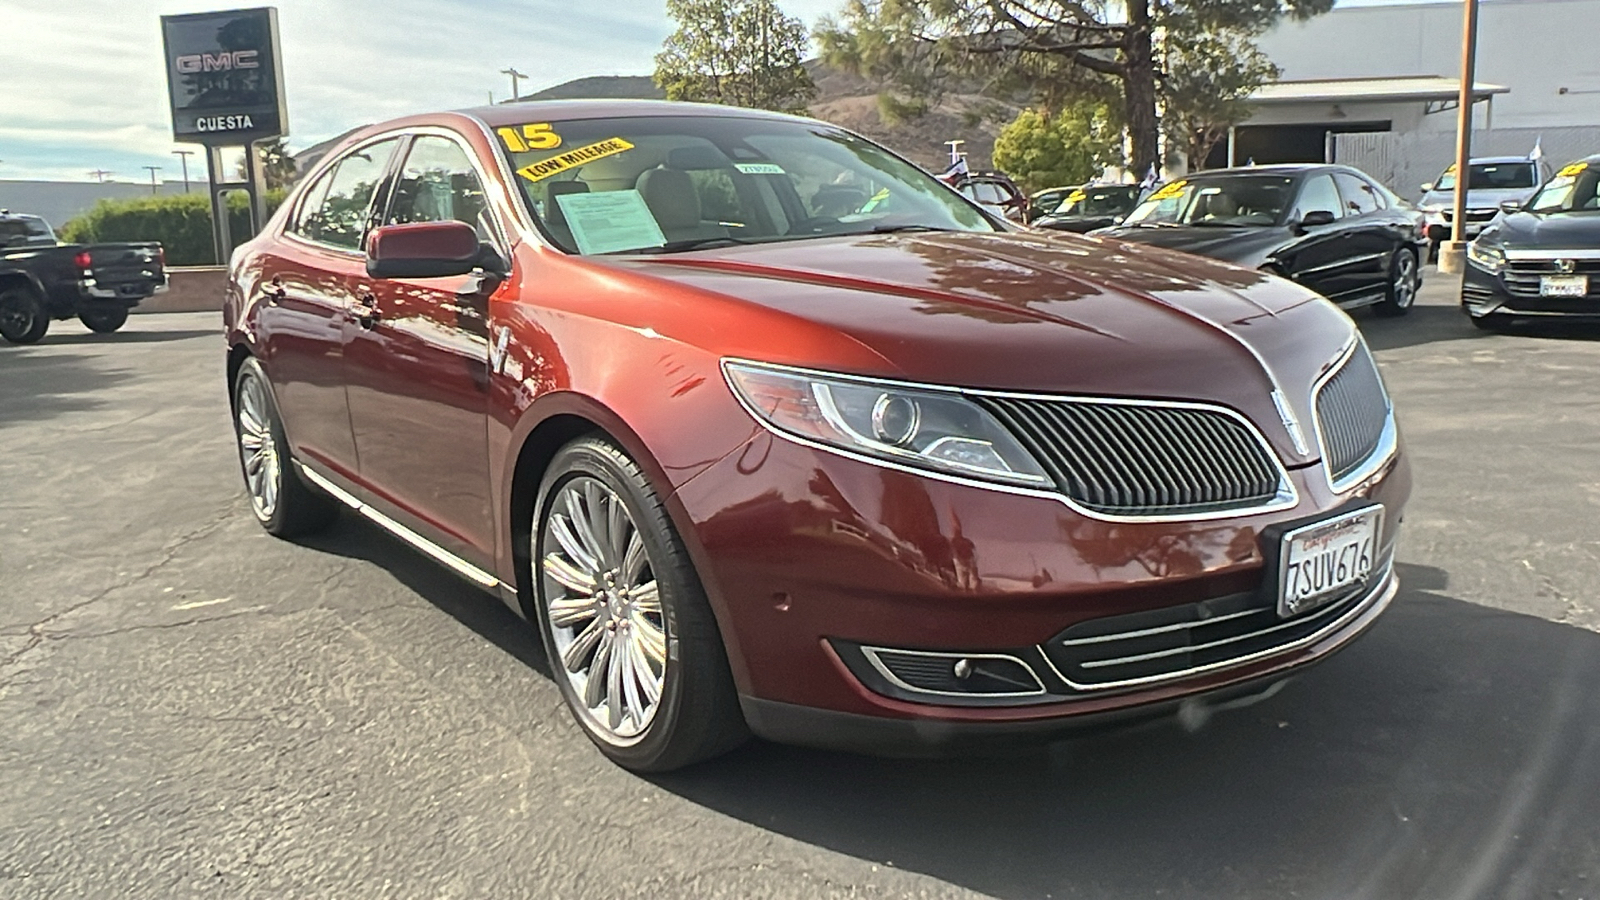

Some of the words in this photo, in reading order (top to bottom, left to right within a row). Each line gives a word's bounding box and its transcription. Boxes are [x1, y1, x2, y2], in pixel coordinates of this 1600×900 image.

[176, 50, 259, 73] GMC
[196, 115, 254, 131] CUESTA
[497, 123, 562, 152] 15
[526, 159, 562, 177] LOW
[561, 140, 623, 165] MILEAGE
[1289, 537, 1370, 597] 7SUV676
